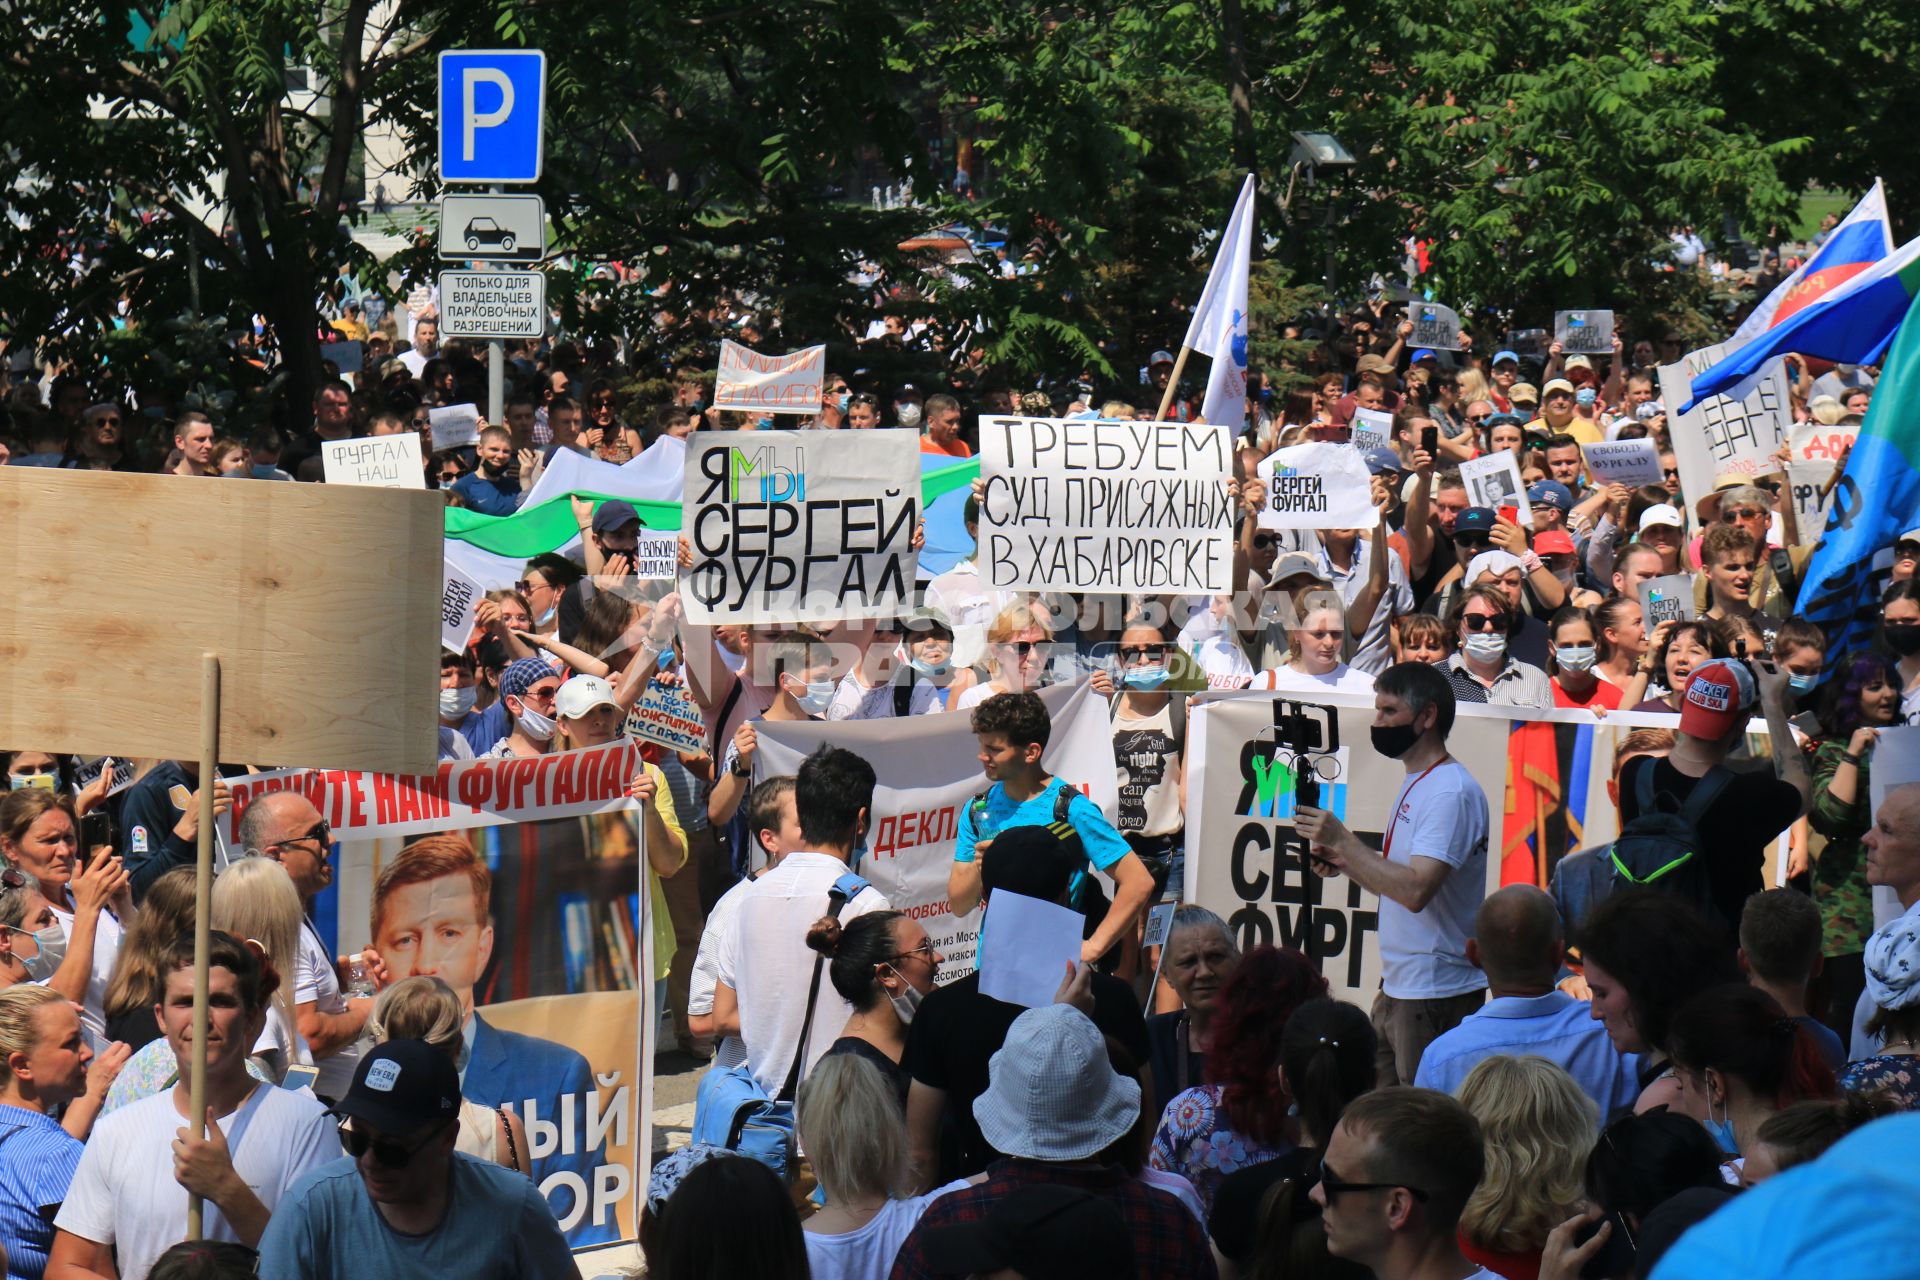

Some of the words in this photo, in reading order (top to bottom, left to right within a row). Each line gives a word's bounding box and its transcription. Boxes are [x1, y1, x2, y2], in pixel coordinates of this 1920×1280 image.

[463, 67, 515, 161] P
[455, 277, 502, 289] ТОЛЬКО
[506, 277, 530, 290] ДЛЯ
[453, 292, 532, 305] ВЛАДЕЛЬЦЕВ
[448, 306, 538, 318] ПАРКОВОЧНЫХ
[453, 319, 532, 332] РАЗРЕШЕНИЙ
[332, 440, 409, 466] ФУРГАЛ
[993, 420, 1223, 472] ТРЕБУЕМ
[1592, 444, 1641, 455] СВОБОДУ
[1592, 456, 1649, 469] ФУРГАЛУ
[357, 463, 400, 482] НАШ
[1272, 474, 1322, 494] СЕРГЕЙ
[984, 475, 1051, 527] СУД
[1066, 477, 1233, 530] ПРИСЯЖНЫХ
[1272, 495, 1327, 512] ФУРГАЛ
[694, 488, 916, 557] СЕРГЕЙ
[639, 541, 676, 558] СВОБОДУ
[639, 560, 674, 576] ФУРГАЛУ
[991, 535, 1019, 586] В
[1027, 534, 1222, 590] ХАБАРОВСКЕ
[690, 552, 908, 612] ФУРГАЛ
[449, 582, 473, 628] ФУРГАЛ
[1692, 677, 1727, 698] HOCKEY
[1129, 751, 1158, 768] right
[373, 764, 450, 825] НАМ
[459, 744, 637, 814] ФУРГАЛА!
[1123, 784, 1144, 796] can
[944, 937, 954, 946] из
[956, 931, 979, 943] Моск
[948, 949, 976, 962] макси
[382, 1070, 395, 1082] ERA
[501, 1071, 629, 1159] ЫЙ
